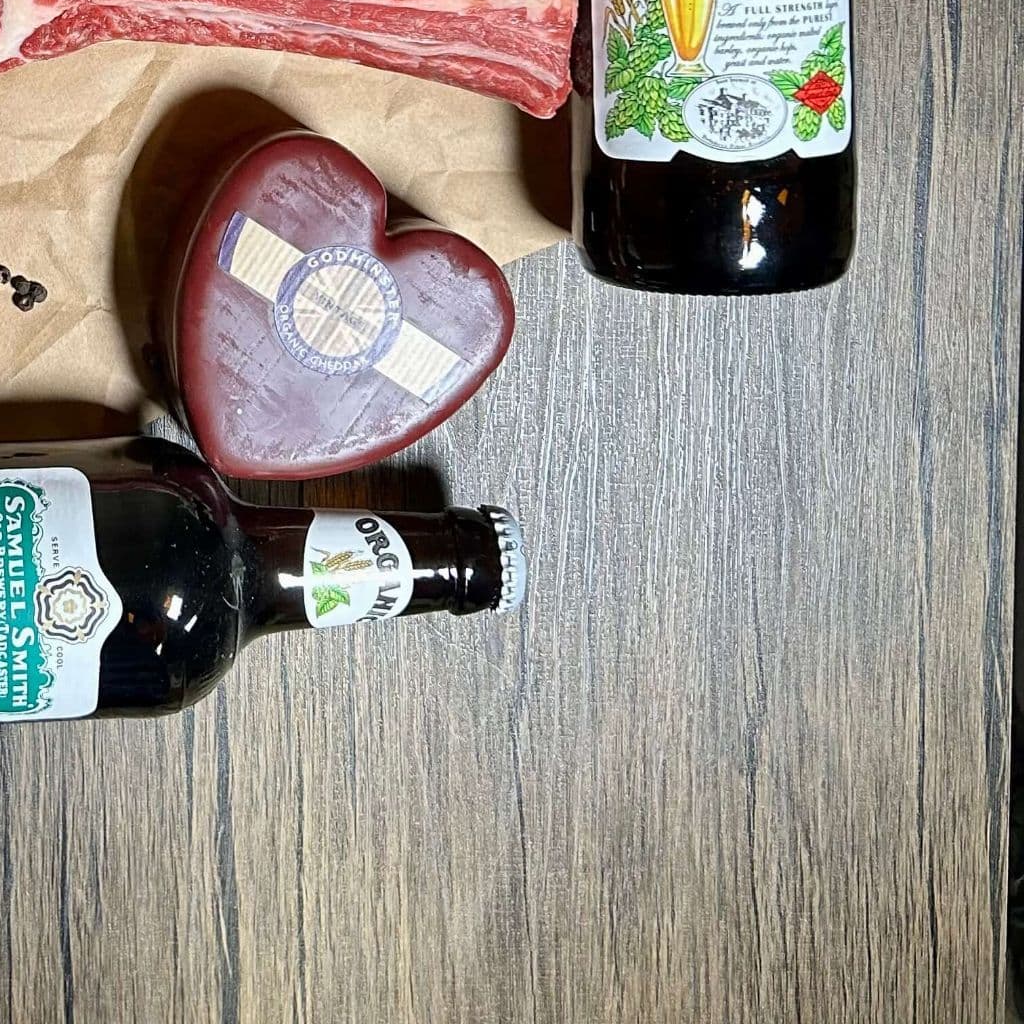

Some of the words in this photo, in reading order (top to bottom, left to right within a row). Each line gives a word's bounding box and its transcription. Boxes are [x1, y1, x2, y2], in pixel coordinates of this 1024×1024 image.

[745, 6, 770, 14] FULL
[776, 2, 823, 13] STRENGTH
[803, 13, 833, 24] PUREST
[307, 248, 400, 328] GODMINSTER
[279, 304, 308, 357] ORGANIC
[310, 356, 370, 371] CHEDDAR
[4, 496, 26, 620] SAMUEL
[51, 536, 59, 568] SERVE
